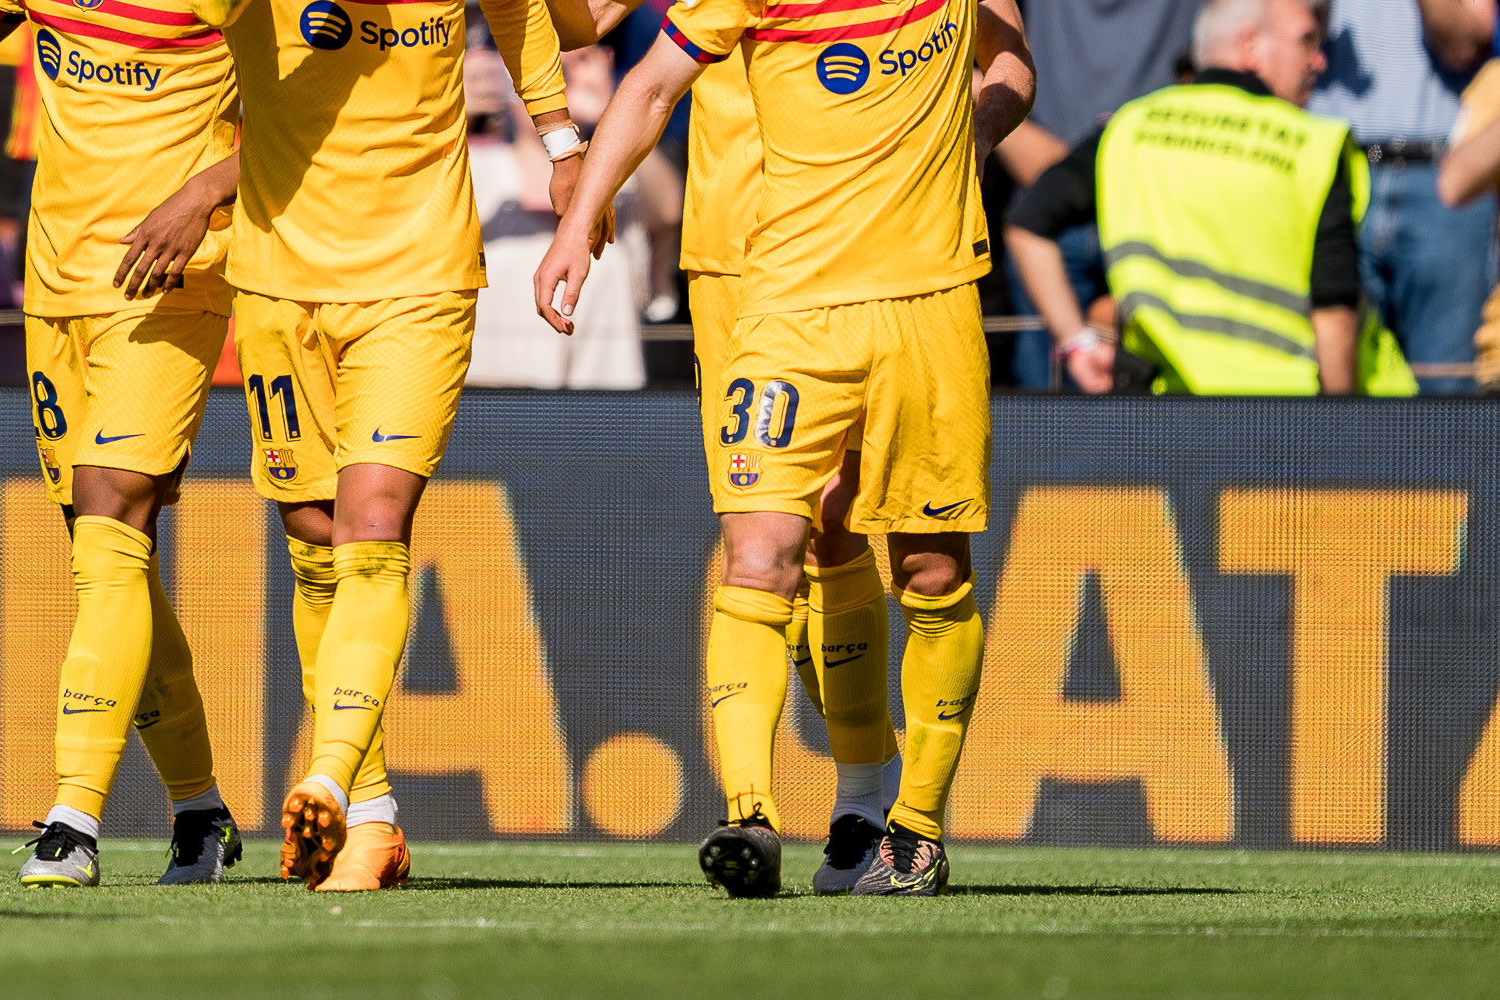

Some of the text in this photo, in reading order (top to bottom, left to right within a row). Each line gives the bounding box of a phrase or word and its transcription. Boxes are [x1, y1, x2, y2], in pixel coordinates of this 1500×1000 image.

[360, 16, 453, 51] Spotify
[66, 50, 162, 92] Spotify
[32, 370, 68, 442] 8
[247, 373, 302, 443] 11
[719, 377, 800, 449] 30
[821, 642, 868, 654] barça
[63, 688, 117, 708] barça
[333, 686, 380, 708] barça
